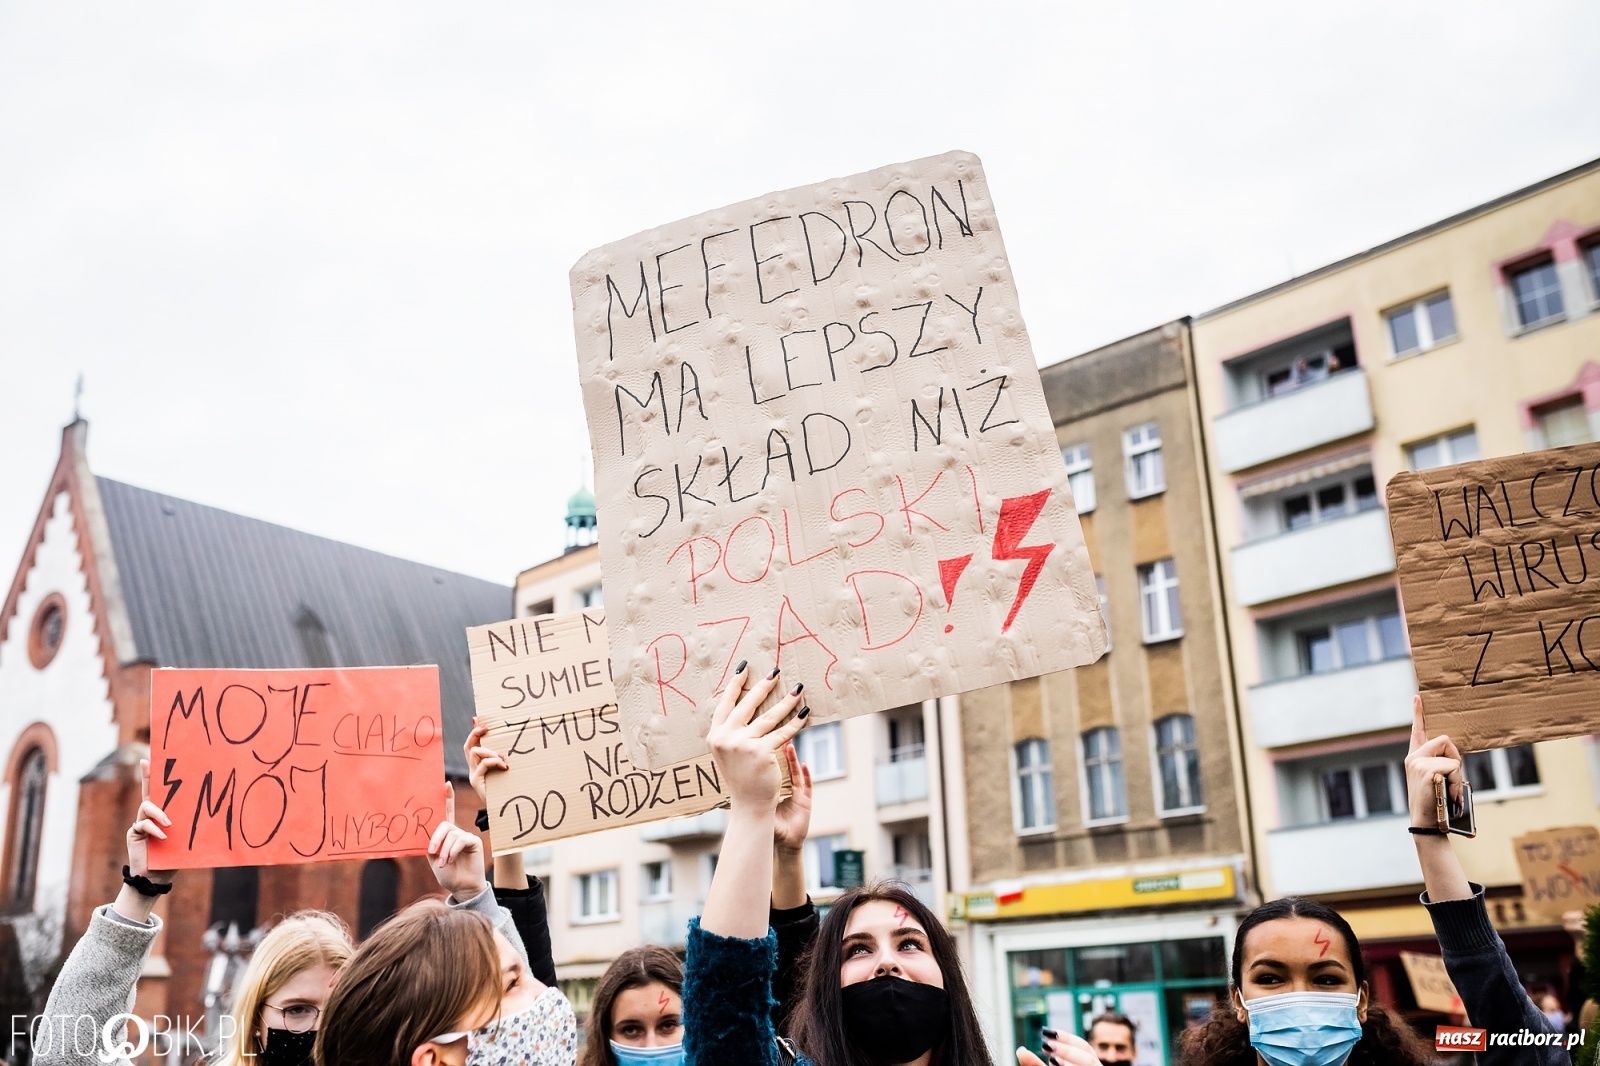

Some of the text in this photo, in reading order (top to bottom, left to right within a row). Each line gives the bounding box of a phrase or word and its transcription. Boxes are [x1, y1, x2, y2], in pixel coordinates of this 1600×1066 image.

[605, 179, 973, 361] MEFEDRON
[614, 286, 983, 456] MA LEPSZY
[634, 369, 1020, 538] SKŁAD NIŻ
[666, 464, 985, 605] POLSKI
[487, 617, 561, 662] NIE
[1466, 631, 1504, 688] Z
[163, 682, 436, 765] MOJE CIAŁO
[188, 759, 434, 858] MÓJ WYBÓR
[499, 789, 567, 841] DO
